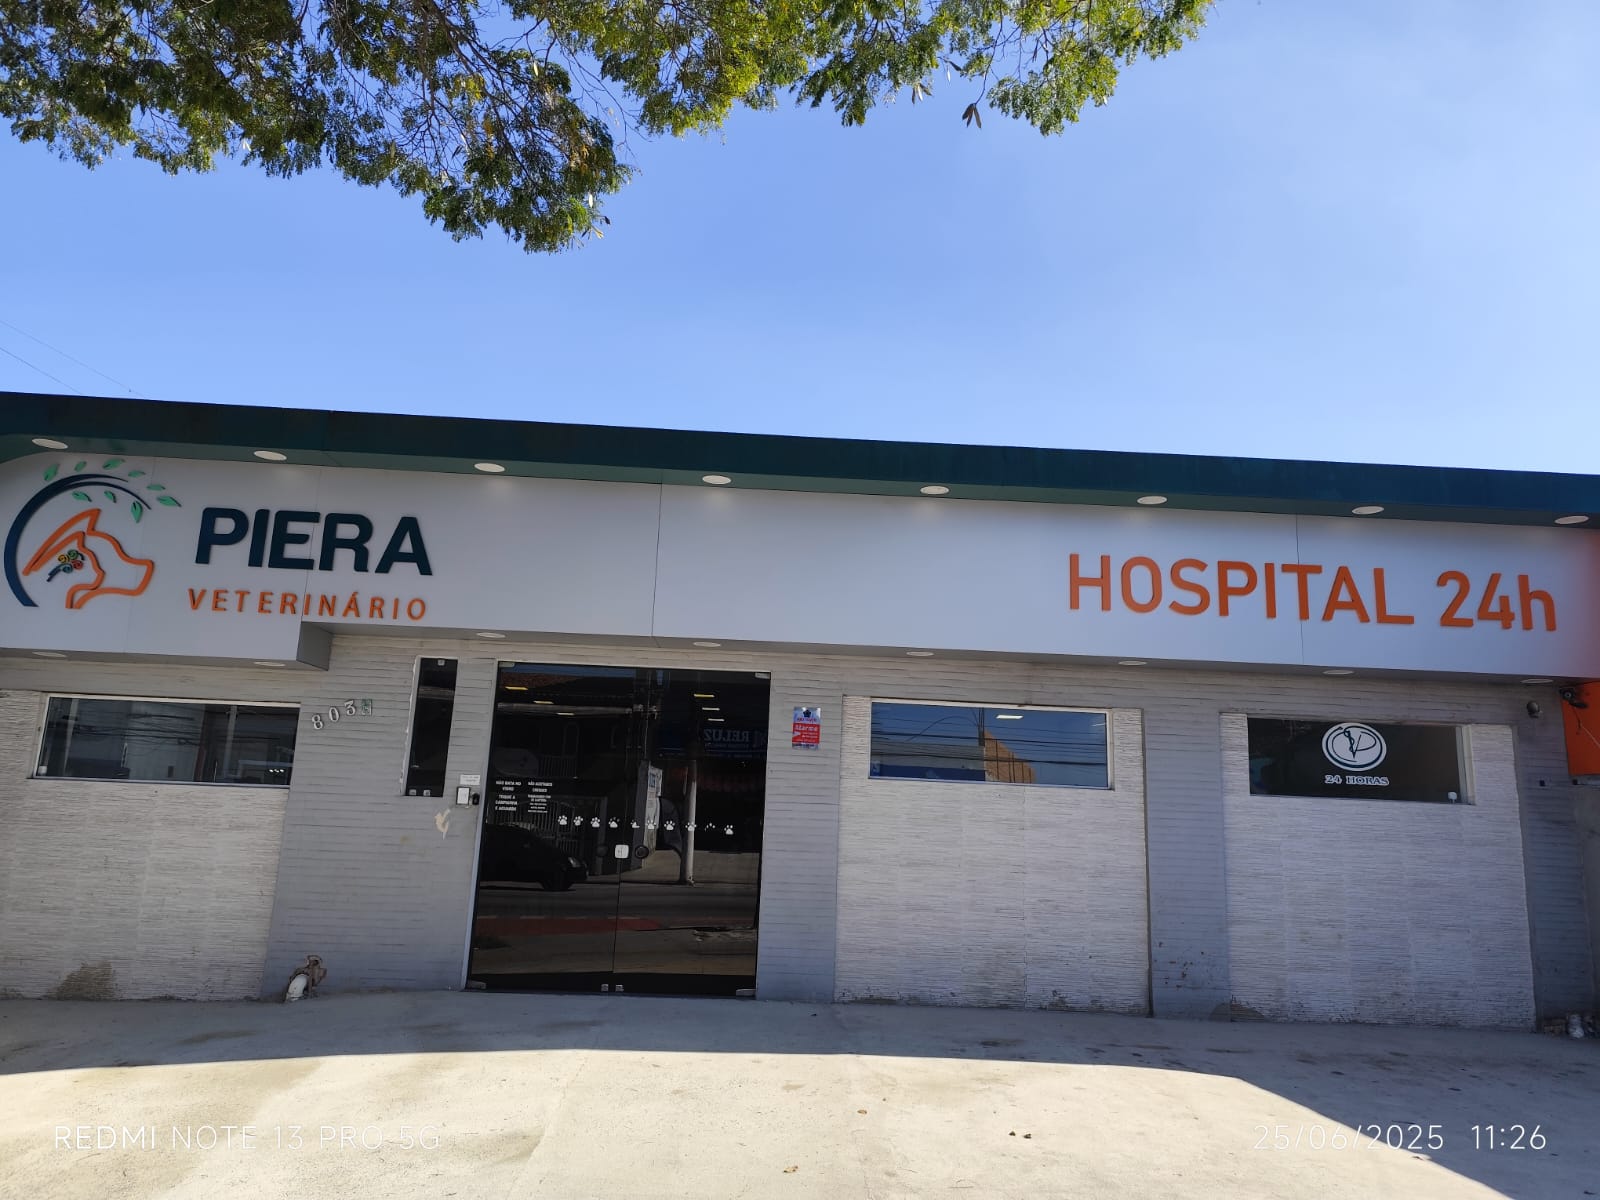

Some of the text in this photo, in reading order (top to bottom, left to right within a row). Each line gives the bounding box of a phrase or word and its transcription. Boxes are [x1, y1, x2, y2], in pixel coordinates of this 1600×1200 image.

[195, 507, 433, 576] PIERA
[187, 588, 427, 621] VETERINÁRIO
[1069, 553, 1557, 632] HOSPITAL 24h
[1324, 774, 1390, 786] 24 HORAS
